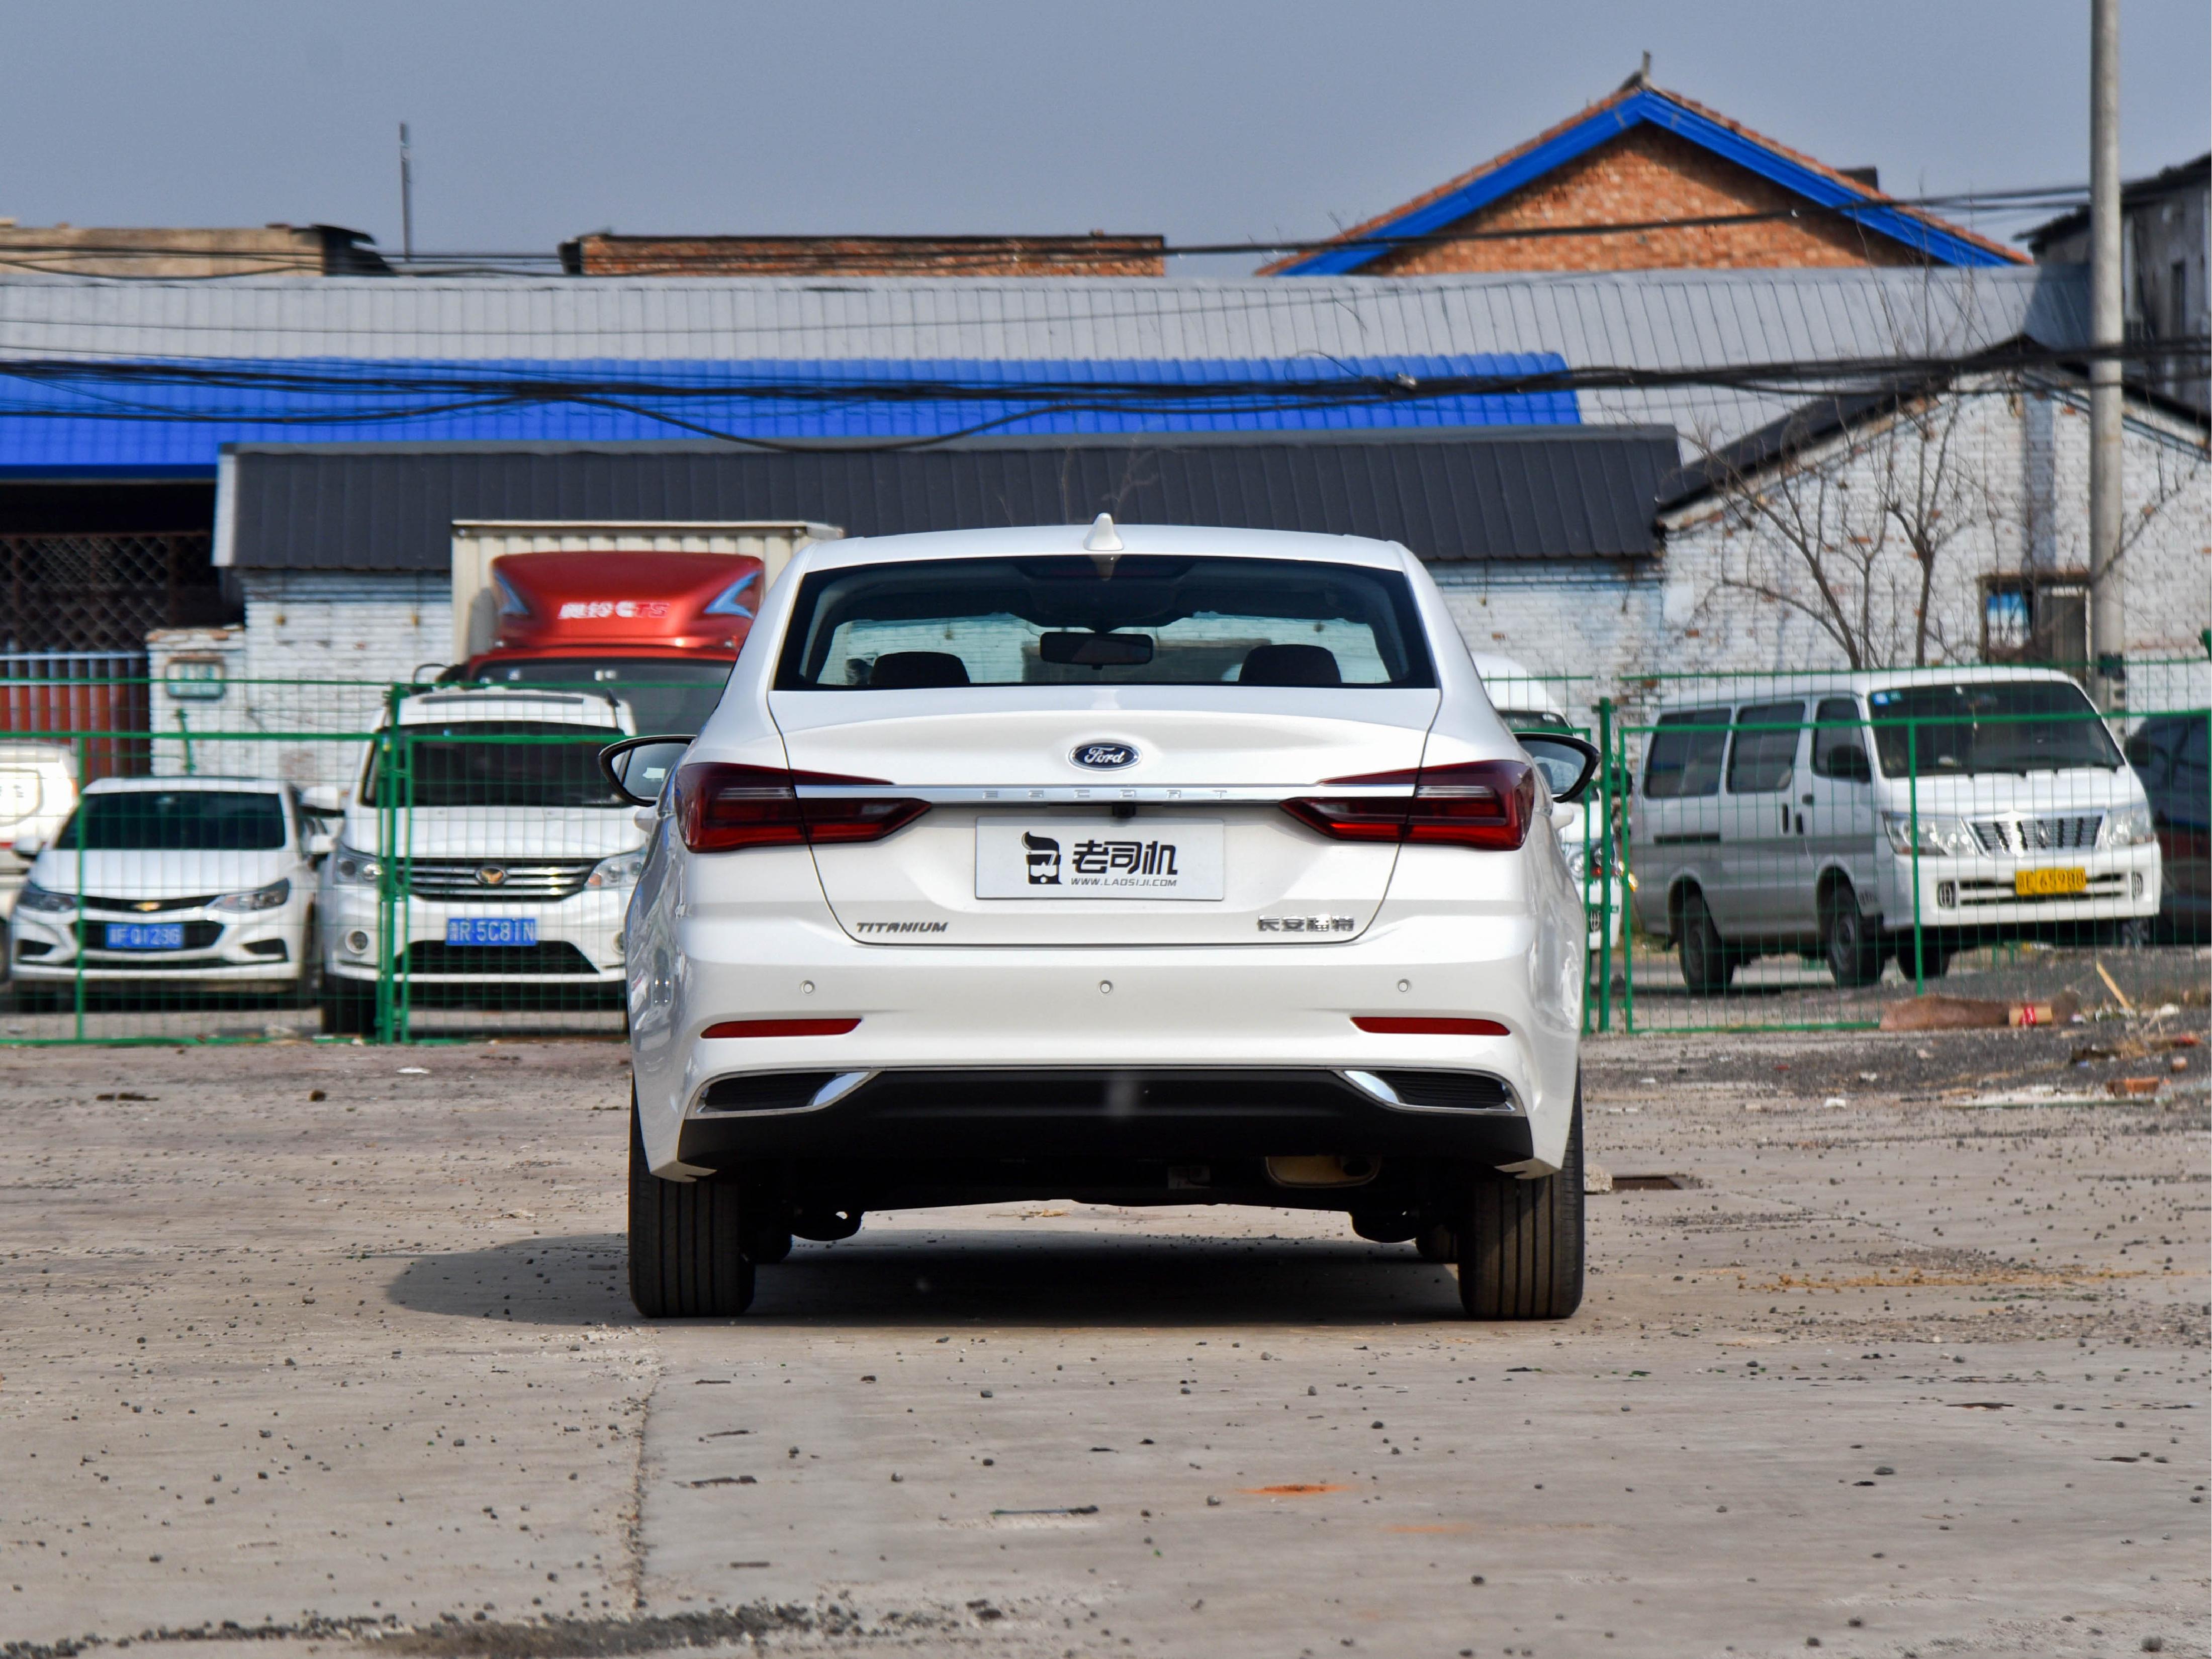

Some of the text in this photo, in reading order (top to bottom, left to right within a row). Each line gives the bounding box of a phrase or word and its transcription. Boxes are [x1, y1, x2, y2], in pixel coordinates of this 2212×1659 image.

[1084, 747, 1126, 763] Ford
[982, 789, 1227, 799] ESCORT
[1072, 840, 1178, 875] 老司机
[1071, 877, 1177, 887] WWW.LAOSIJI.COM
[857, 921, 949, 933] TITANIUM
[1258, 915, 1354, 932] 长安福特
